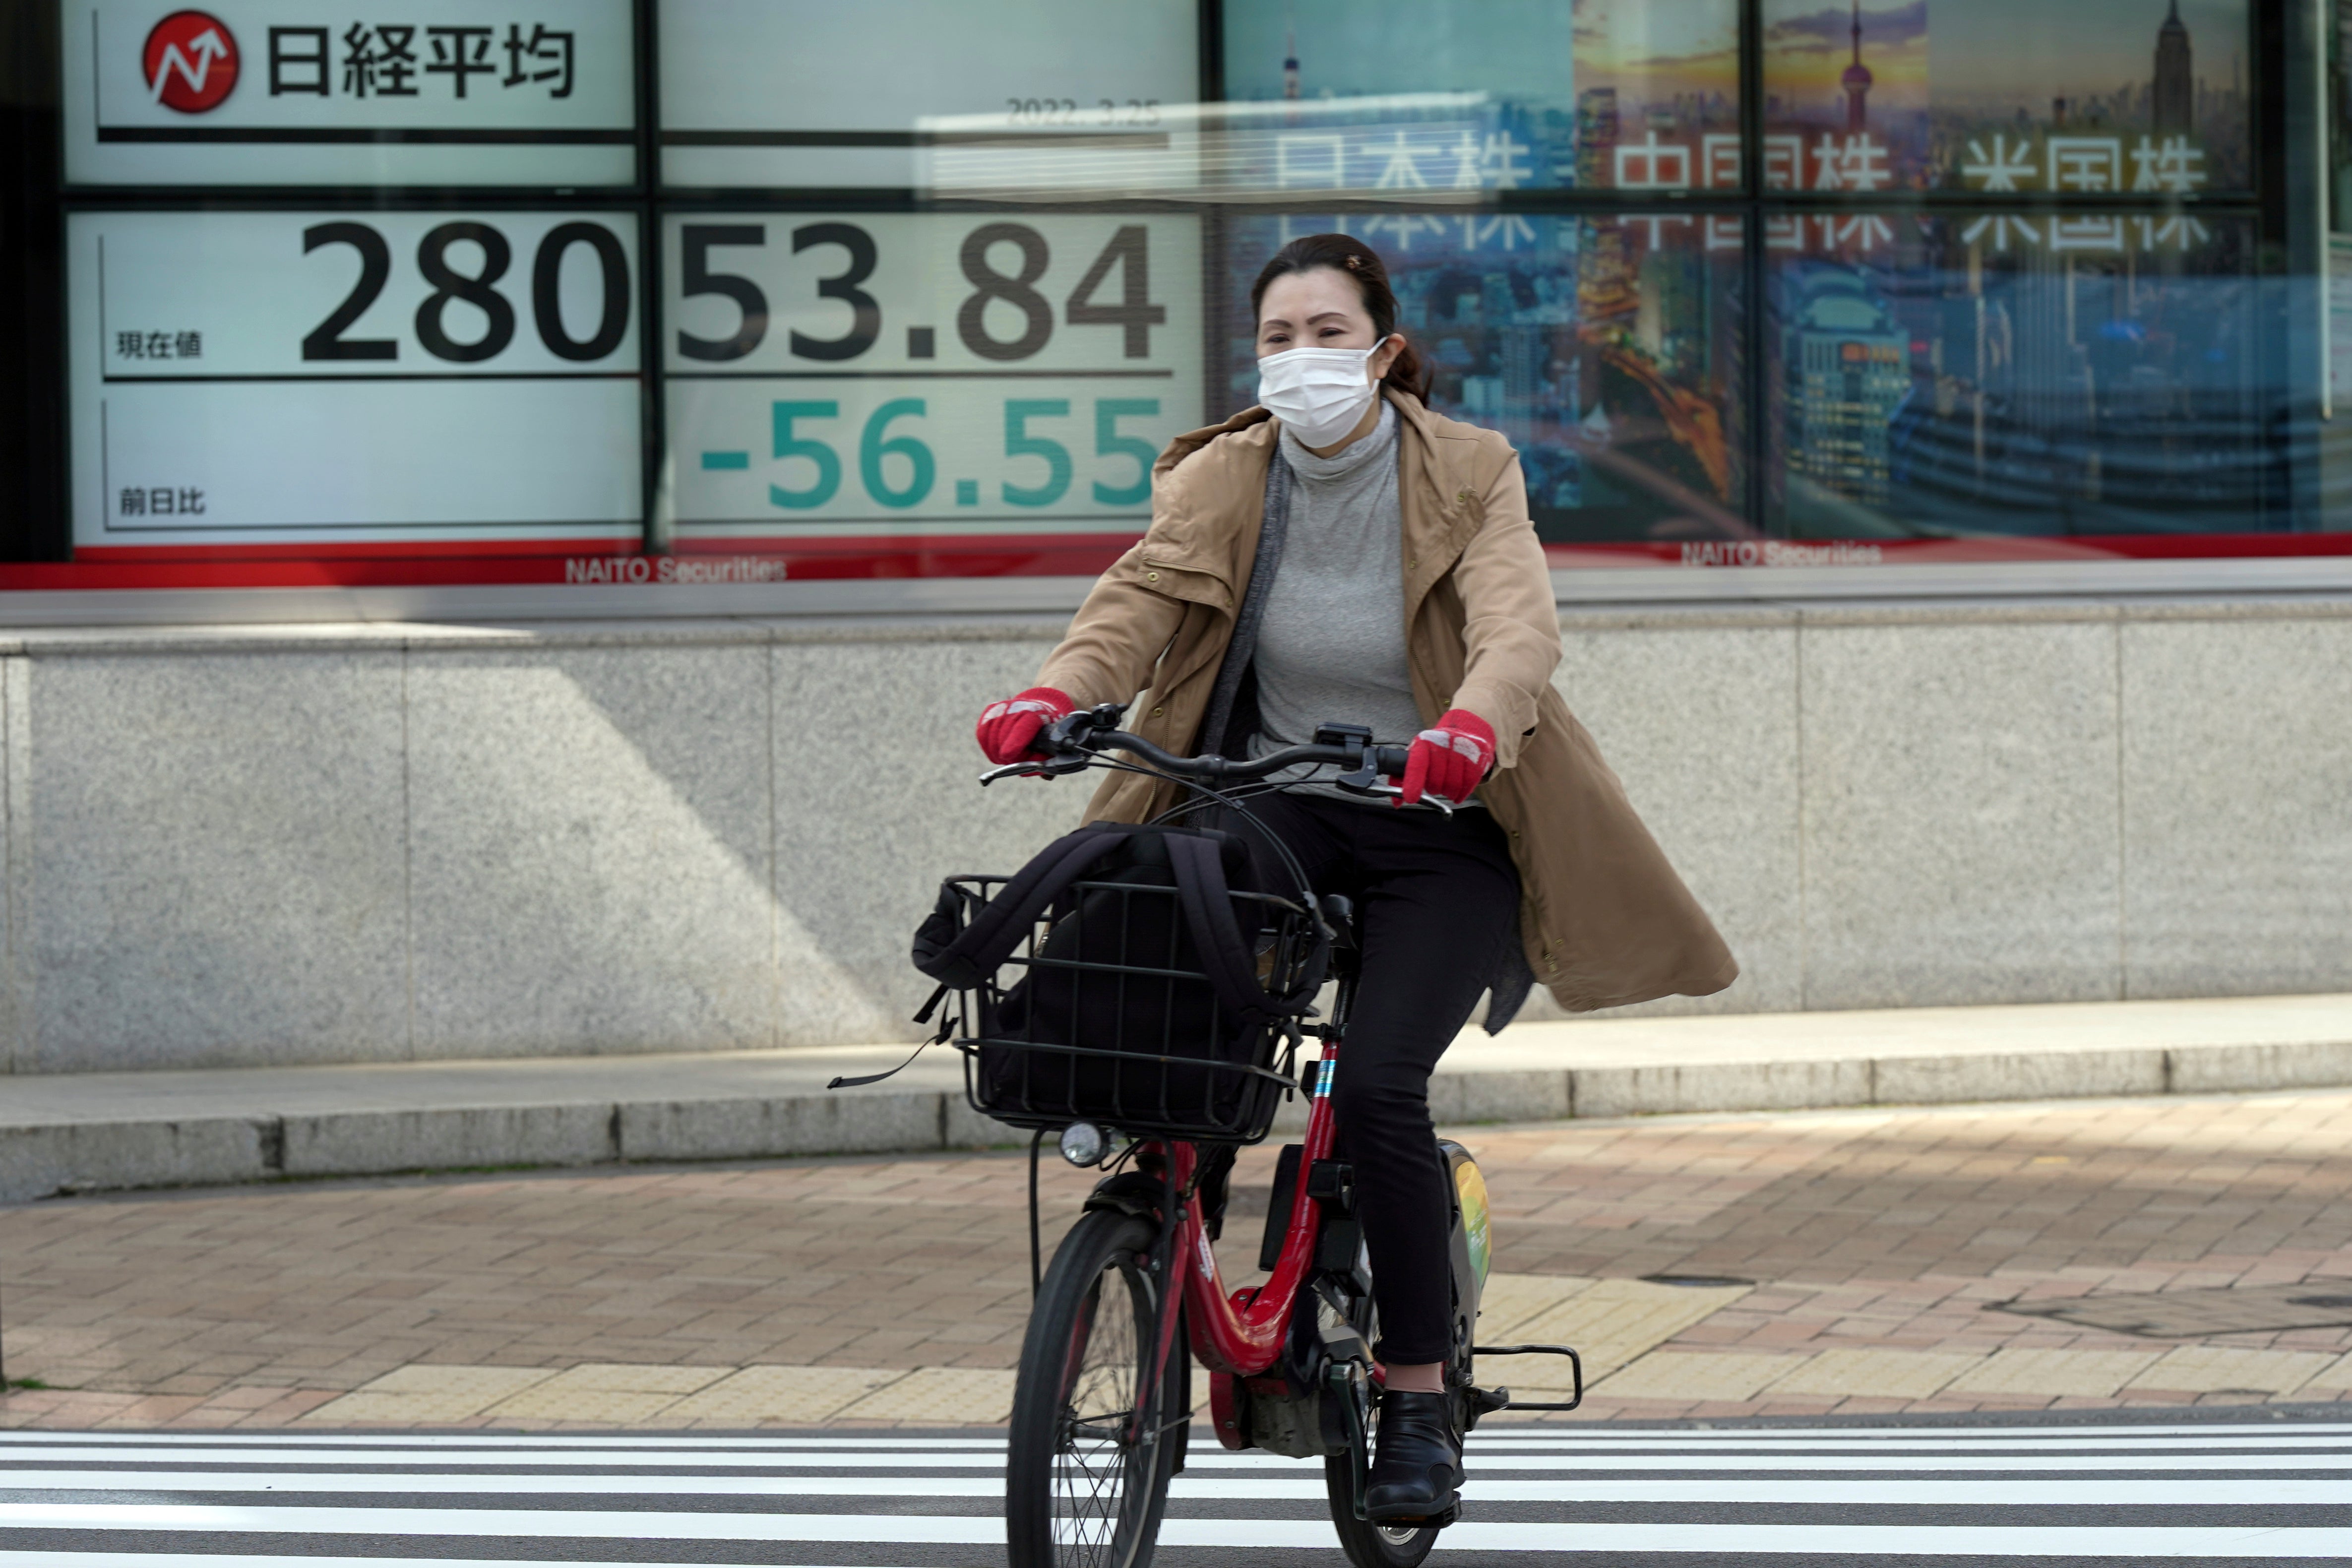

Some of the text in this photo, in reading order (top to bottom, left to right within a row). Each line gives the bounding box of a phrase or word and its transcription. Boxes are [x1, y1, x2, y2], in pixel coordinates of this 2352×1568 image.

[268, 22, 575, 99] 日経平均
[1276, 130, 1536, 251] 日本株
[1614, 130, 1893, 251] 中国株
[1961, 134, 2210, 251] 米国株
[302, 220, 1167, 363] 28053.84
[117, 330, 202, 360] 現在値
[700, 398, 1161, 510] -56.55
[120, 487, 205, 516] 前日比
[565, 556, 788, 584] NAITO Securities
[1681, 539, 1883, 566] NAITO Securities
